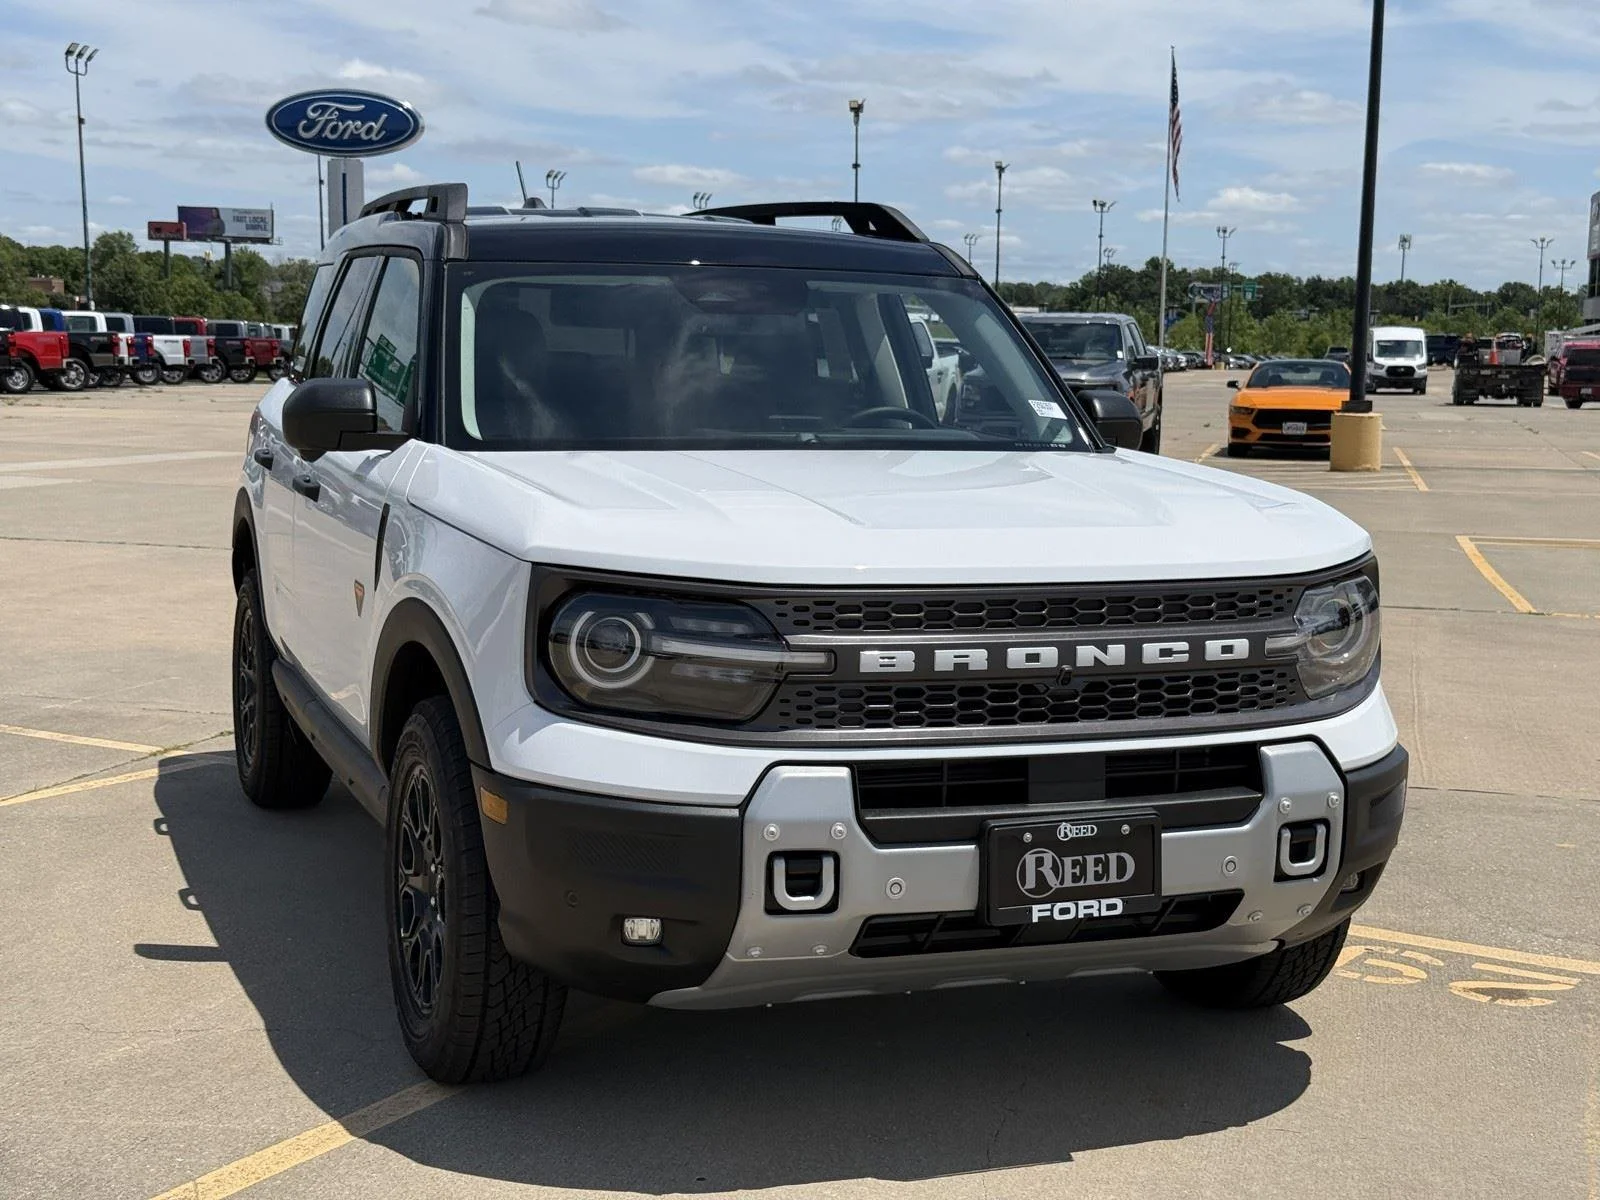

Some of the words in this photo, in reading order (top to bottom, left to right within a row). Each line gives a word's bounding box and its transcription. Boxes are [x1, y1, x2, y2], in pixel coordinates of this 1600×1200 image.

[298, 101, 388, 140] Ford
[859, 638, 1250, 673] BRONCO
[1057, 822, 1098, 841] REED
[1019, 850, 1136, 893] REED
[1032, 898, 1124, 923] FORD
